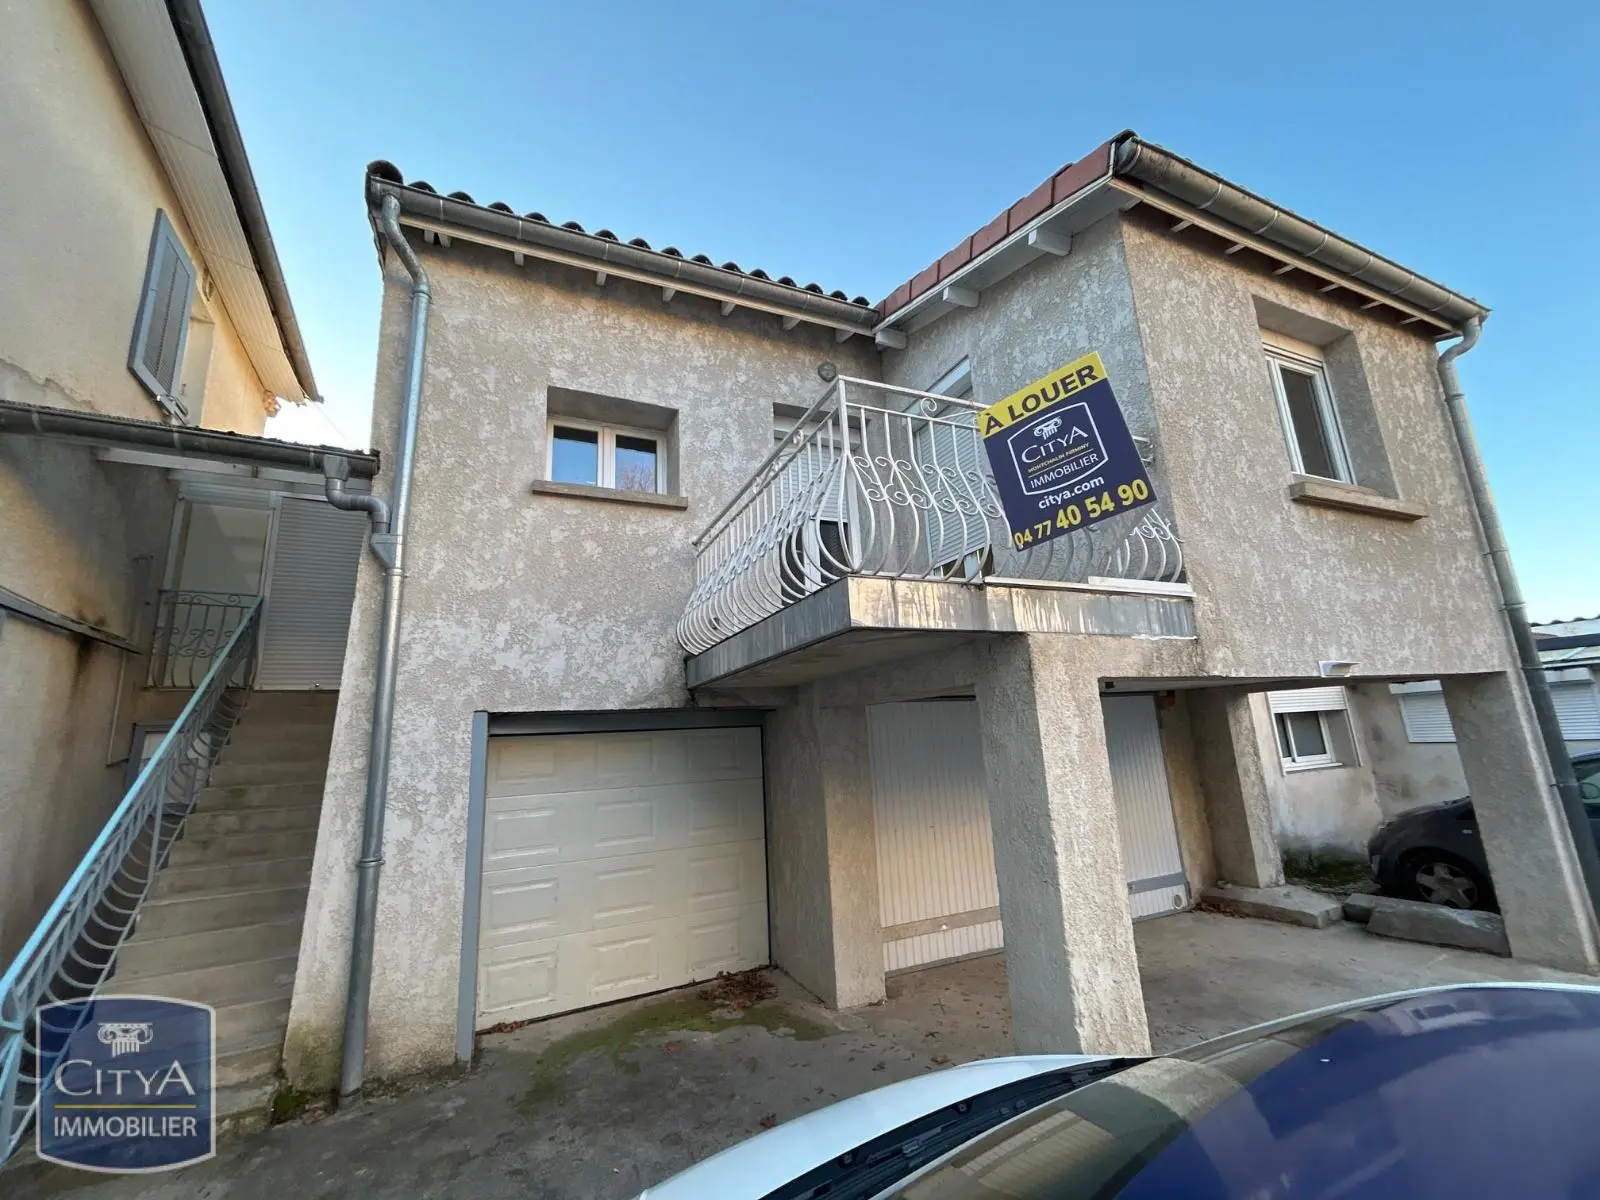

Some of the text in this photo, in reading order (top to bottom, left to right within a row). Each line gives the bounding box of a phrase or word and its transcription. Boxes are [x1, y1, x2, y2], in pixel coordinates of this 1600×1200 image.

[1007, 364, 1099, 421] LOUER
[1030, 453, 1099, 488] IMMOBILIER
[1038, 476, 1105, 509] citya.com
[1014, 478, 1149, 547] 04 77 40 54 90
